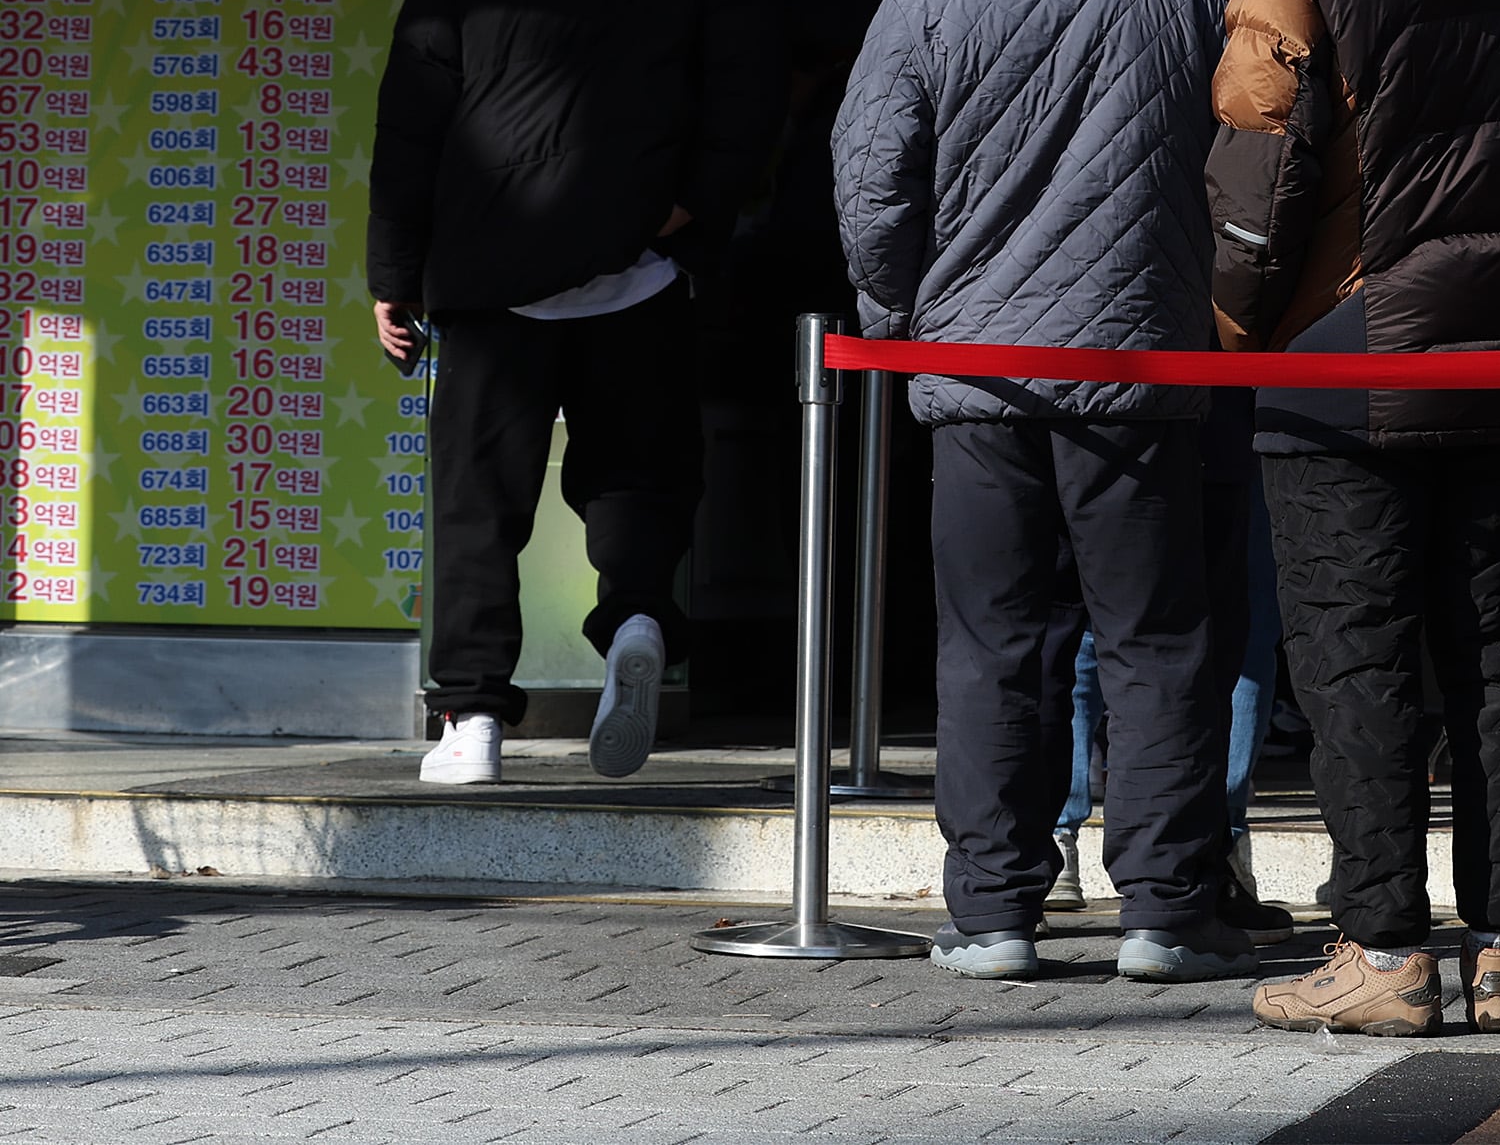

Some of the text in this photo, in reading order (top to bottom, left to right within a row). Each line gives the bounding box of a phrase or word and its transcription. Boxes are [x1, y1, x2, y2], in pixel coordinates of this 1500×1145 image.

[155, 17, 219, 40] 575회
[153, 54, 218, 77] 576회
[152, 91, 217, 114] 598회
[151, 128, 216, 151] 606회
[149, 165, 215, 188] 606회
[148, 202, 214, 226] 624회
[147, 242, 213, 265] 635회
[146, 279, 212, 303] 647회
[145, 317, 211, 341] 655회
[144, 355, 210, 379] 655회
[143, 392, 209, 416] 663회
[142, 430, 208, 453] 668회
[141, 468, 207, 491] 674회
[140, 505, 206, 528] 685회
[139, 544, 205, 568] 723회
[138, 582, 204, 606] 734회
